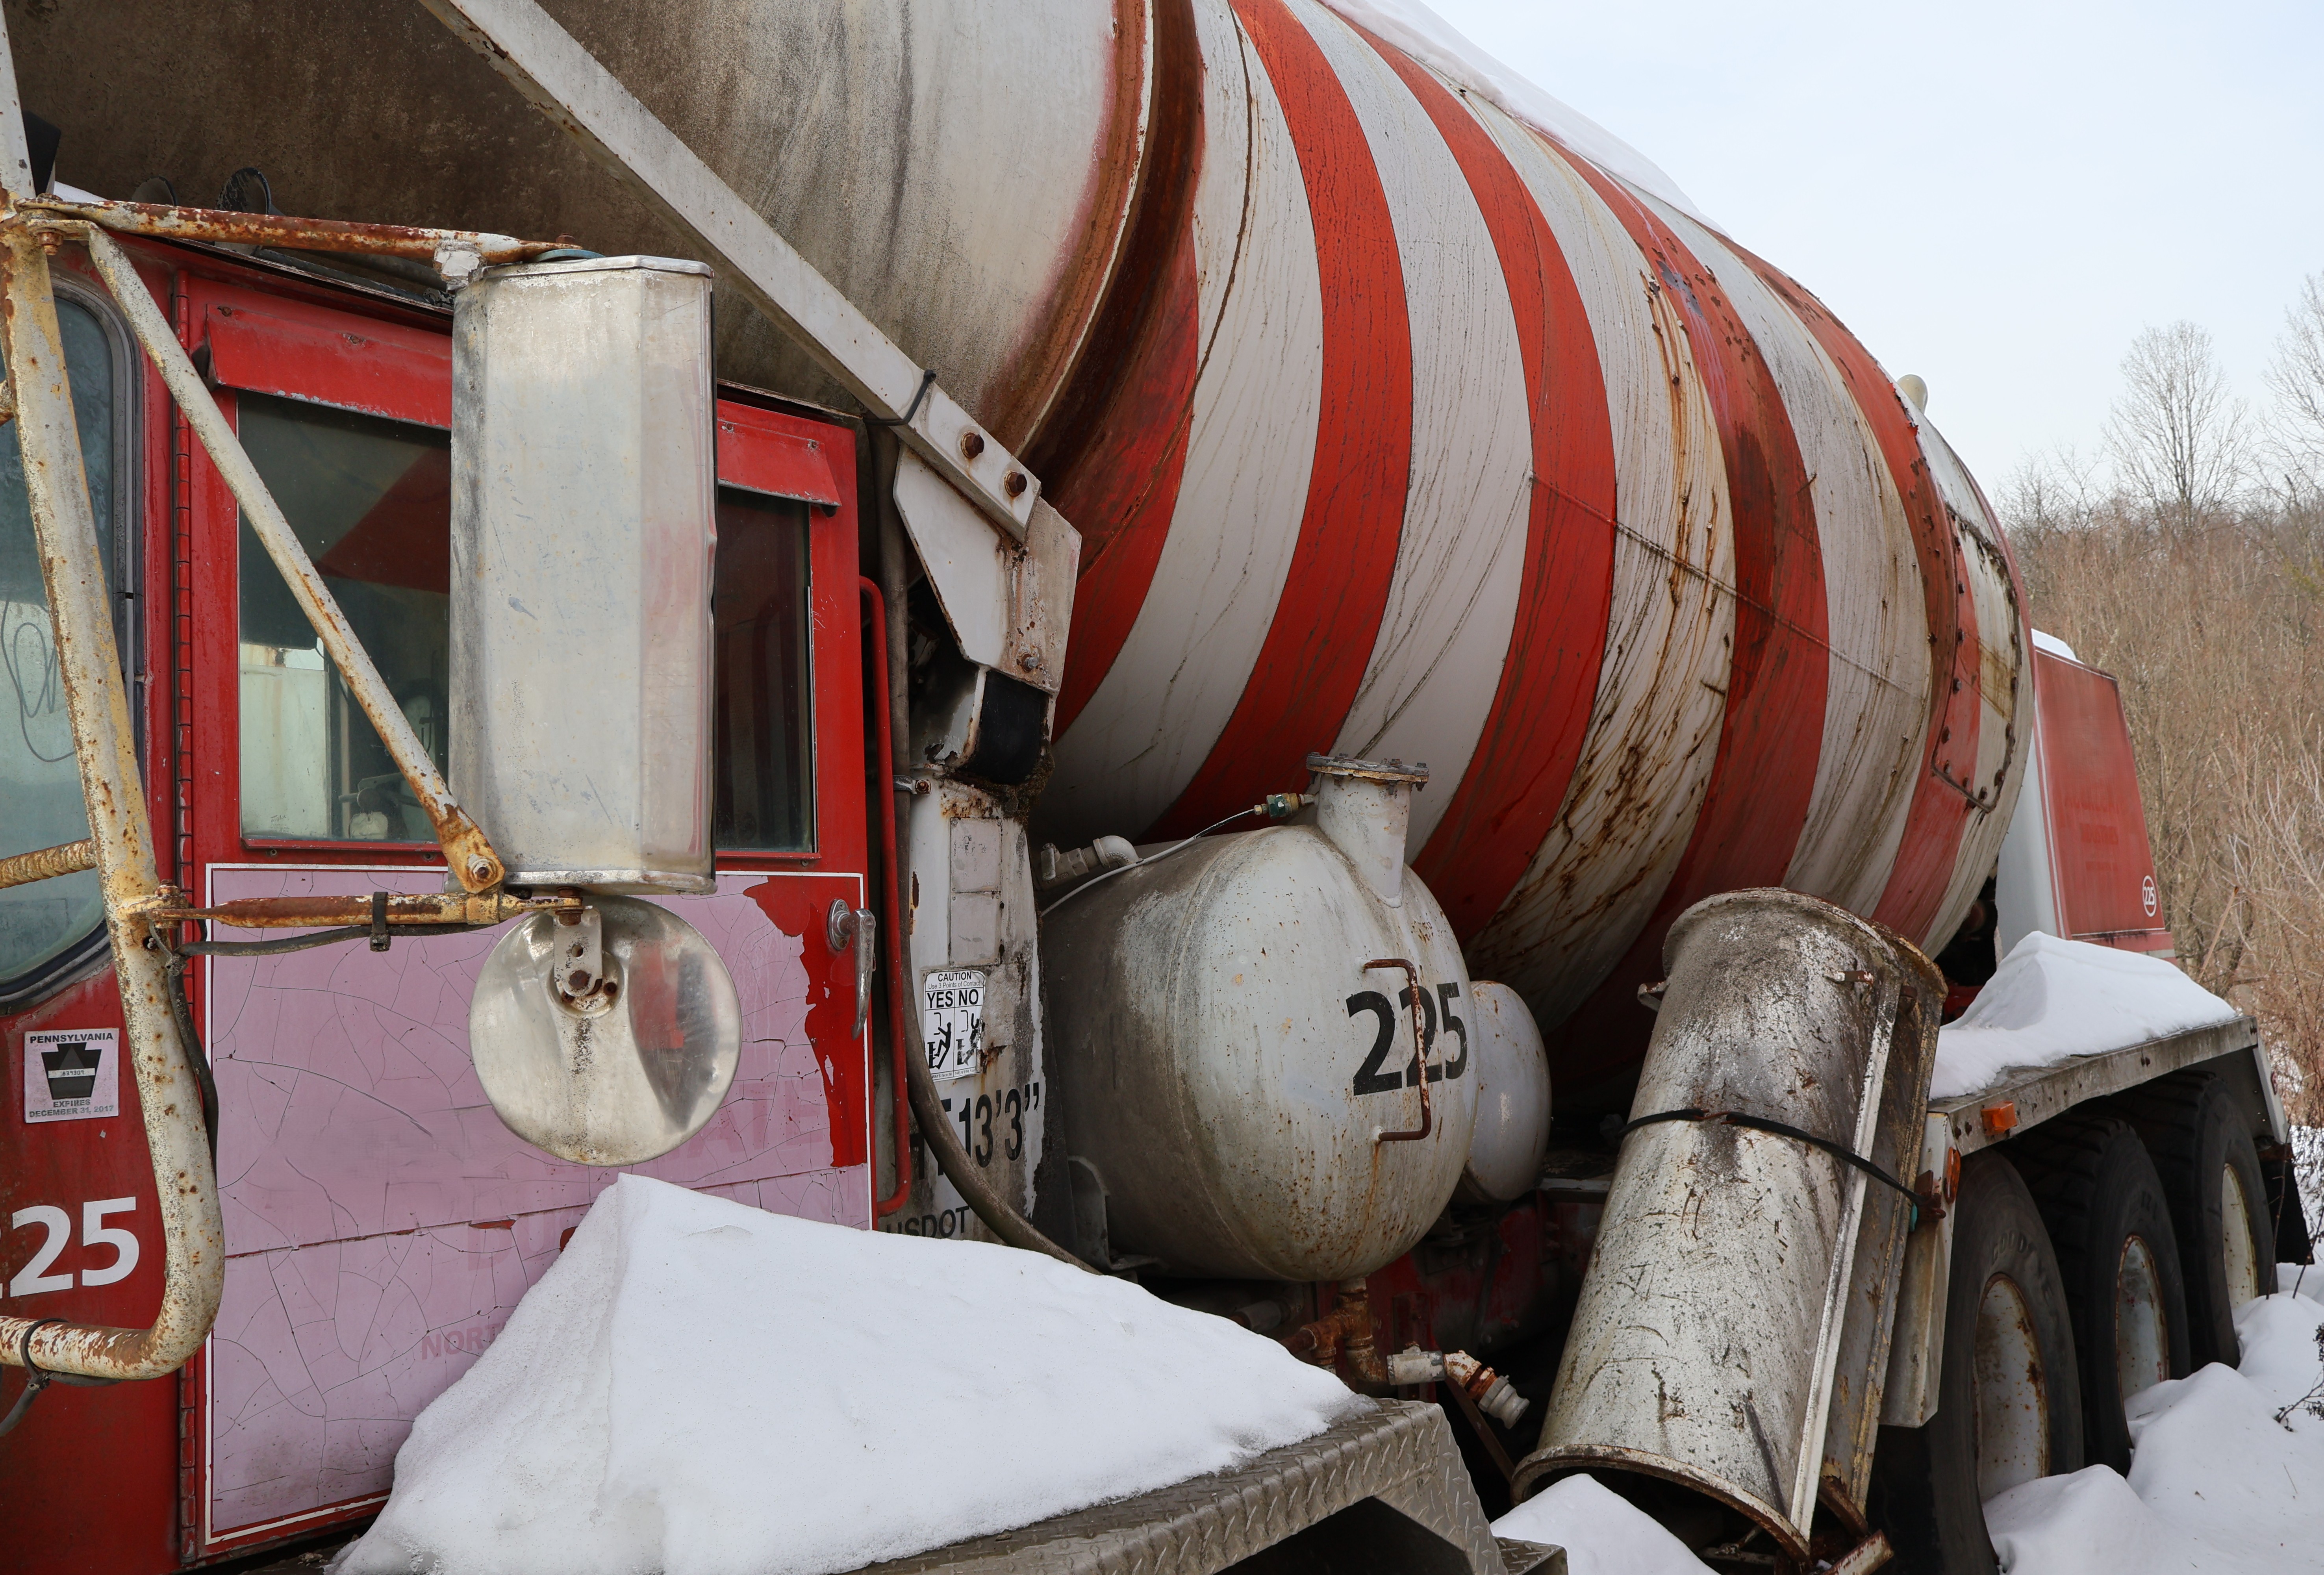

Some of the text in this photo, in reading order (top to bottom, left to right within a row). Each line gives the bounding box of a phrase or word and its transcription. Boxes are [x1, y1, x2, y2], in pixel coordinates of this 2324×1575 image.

[2144, 886, 2155, 905] 225
[938, 971, 972, 982] CAUTION
[927, 990, 953, 1009] YES
[959, 989, 979, 1006] NO
[30, 1033, 114, 1043] PENNSYLVANIA
[1345, 982, 1468, 1096] 225
[29, 1107, 78, 1117] DECEMBER
[53, 1099, 91, 1108] EXPIRES
[0, 1197, 139, 1298] 25
[422, 1320, 506, 1360] NORT
